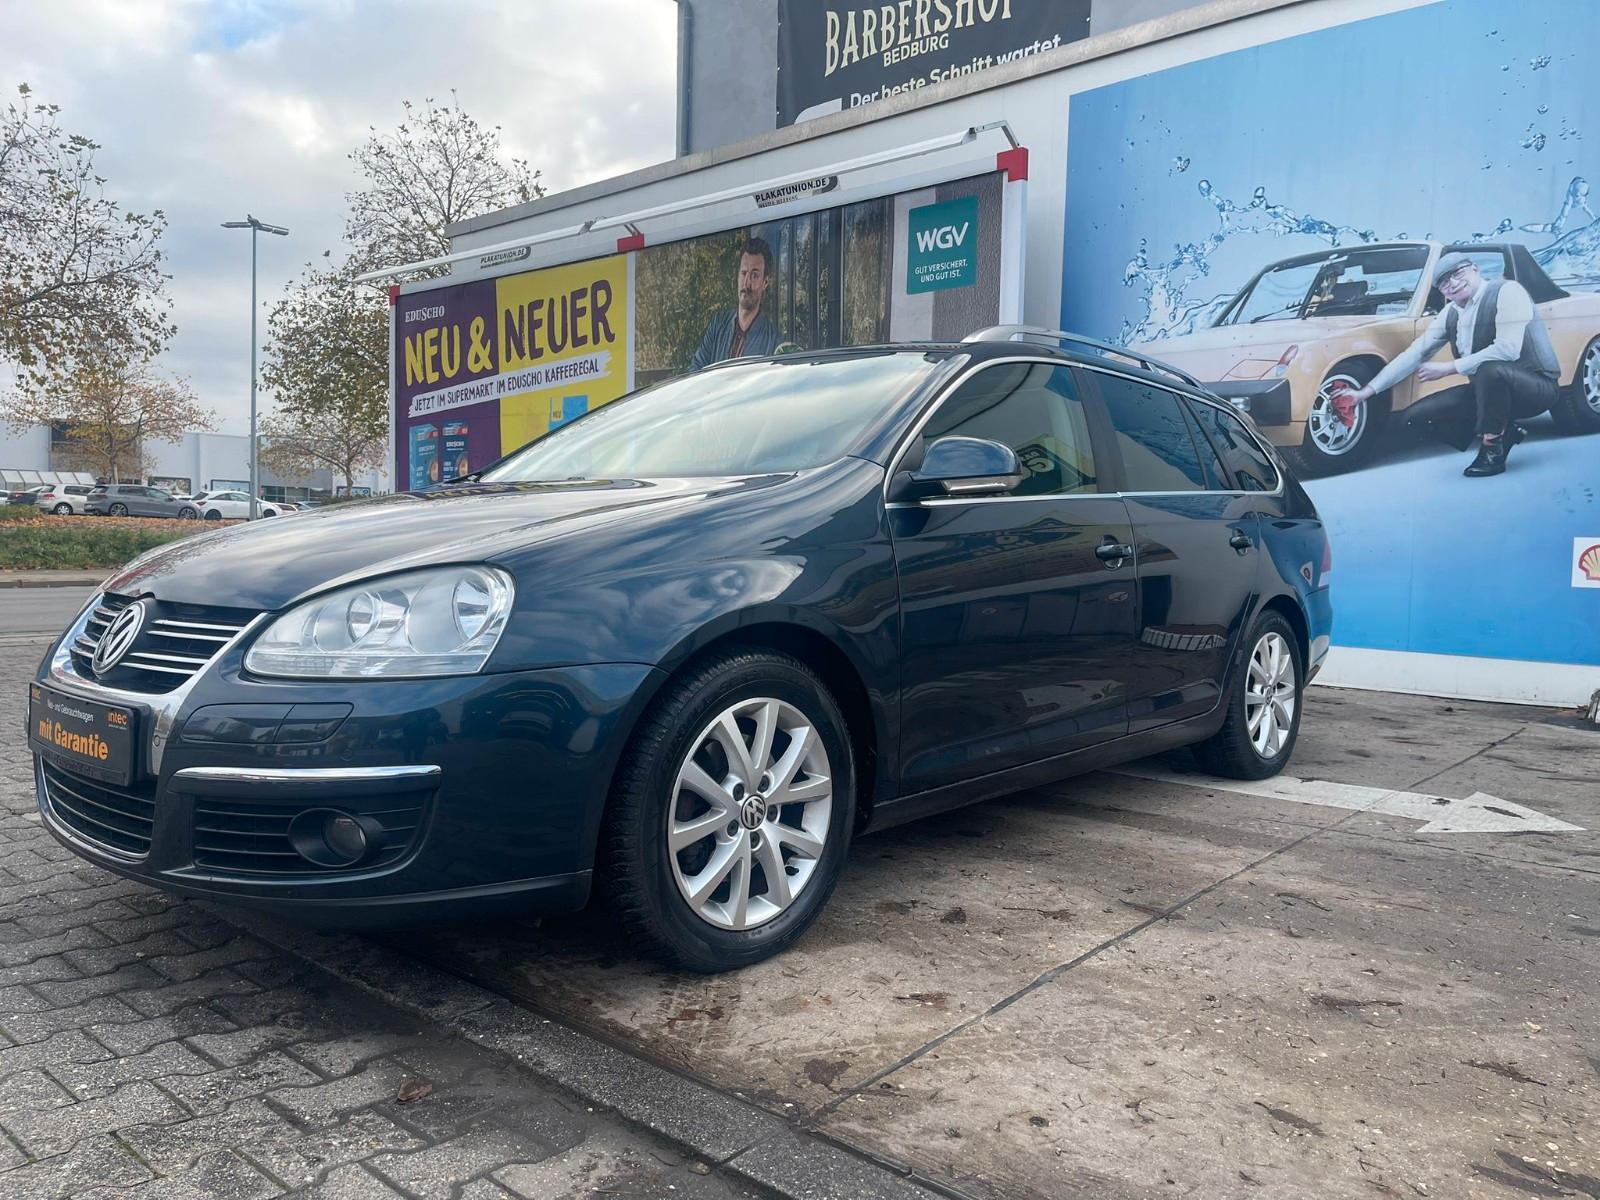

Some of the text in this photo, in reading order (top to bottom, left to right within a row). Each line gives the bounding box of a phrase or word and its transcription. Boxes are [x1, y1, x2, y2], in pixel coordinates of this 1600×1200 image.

[883, 33, 949, 67] BEDBURG
[850, 91, 879, 109] Der
[881, 77, 926, 101] beste
[929, 54, 993, 84] Schnitt
[755, 177, 827, 203] PLAKATUNION.DE
[916, 221, 969, 253] WGV
[914, 265, 928, 275] GUT
[920, 273, 935, 283] UND
[935, 271, 949, 281] GUT
[404, 279, 616, 387] NEU & NEUER
[414, 358, 600, 412] JETZT IM SUPERMARKT IM EDUSCHO KAFFEEREGAL
[39, 717, 108, 761] mit Garantie
